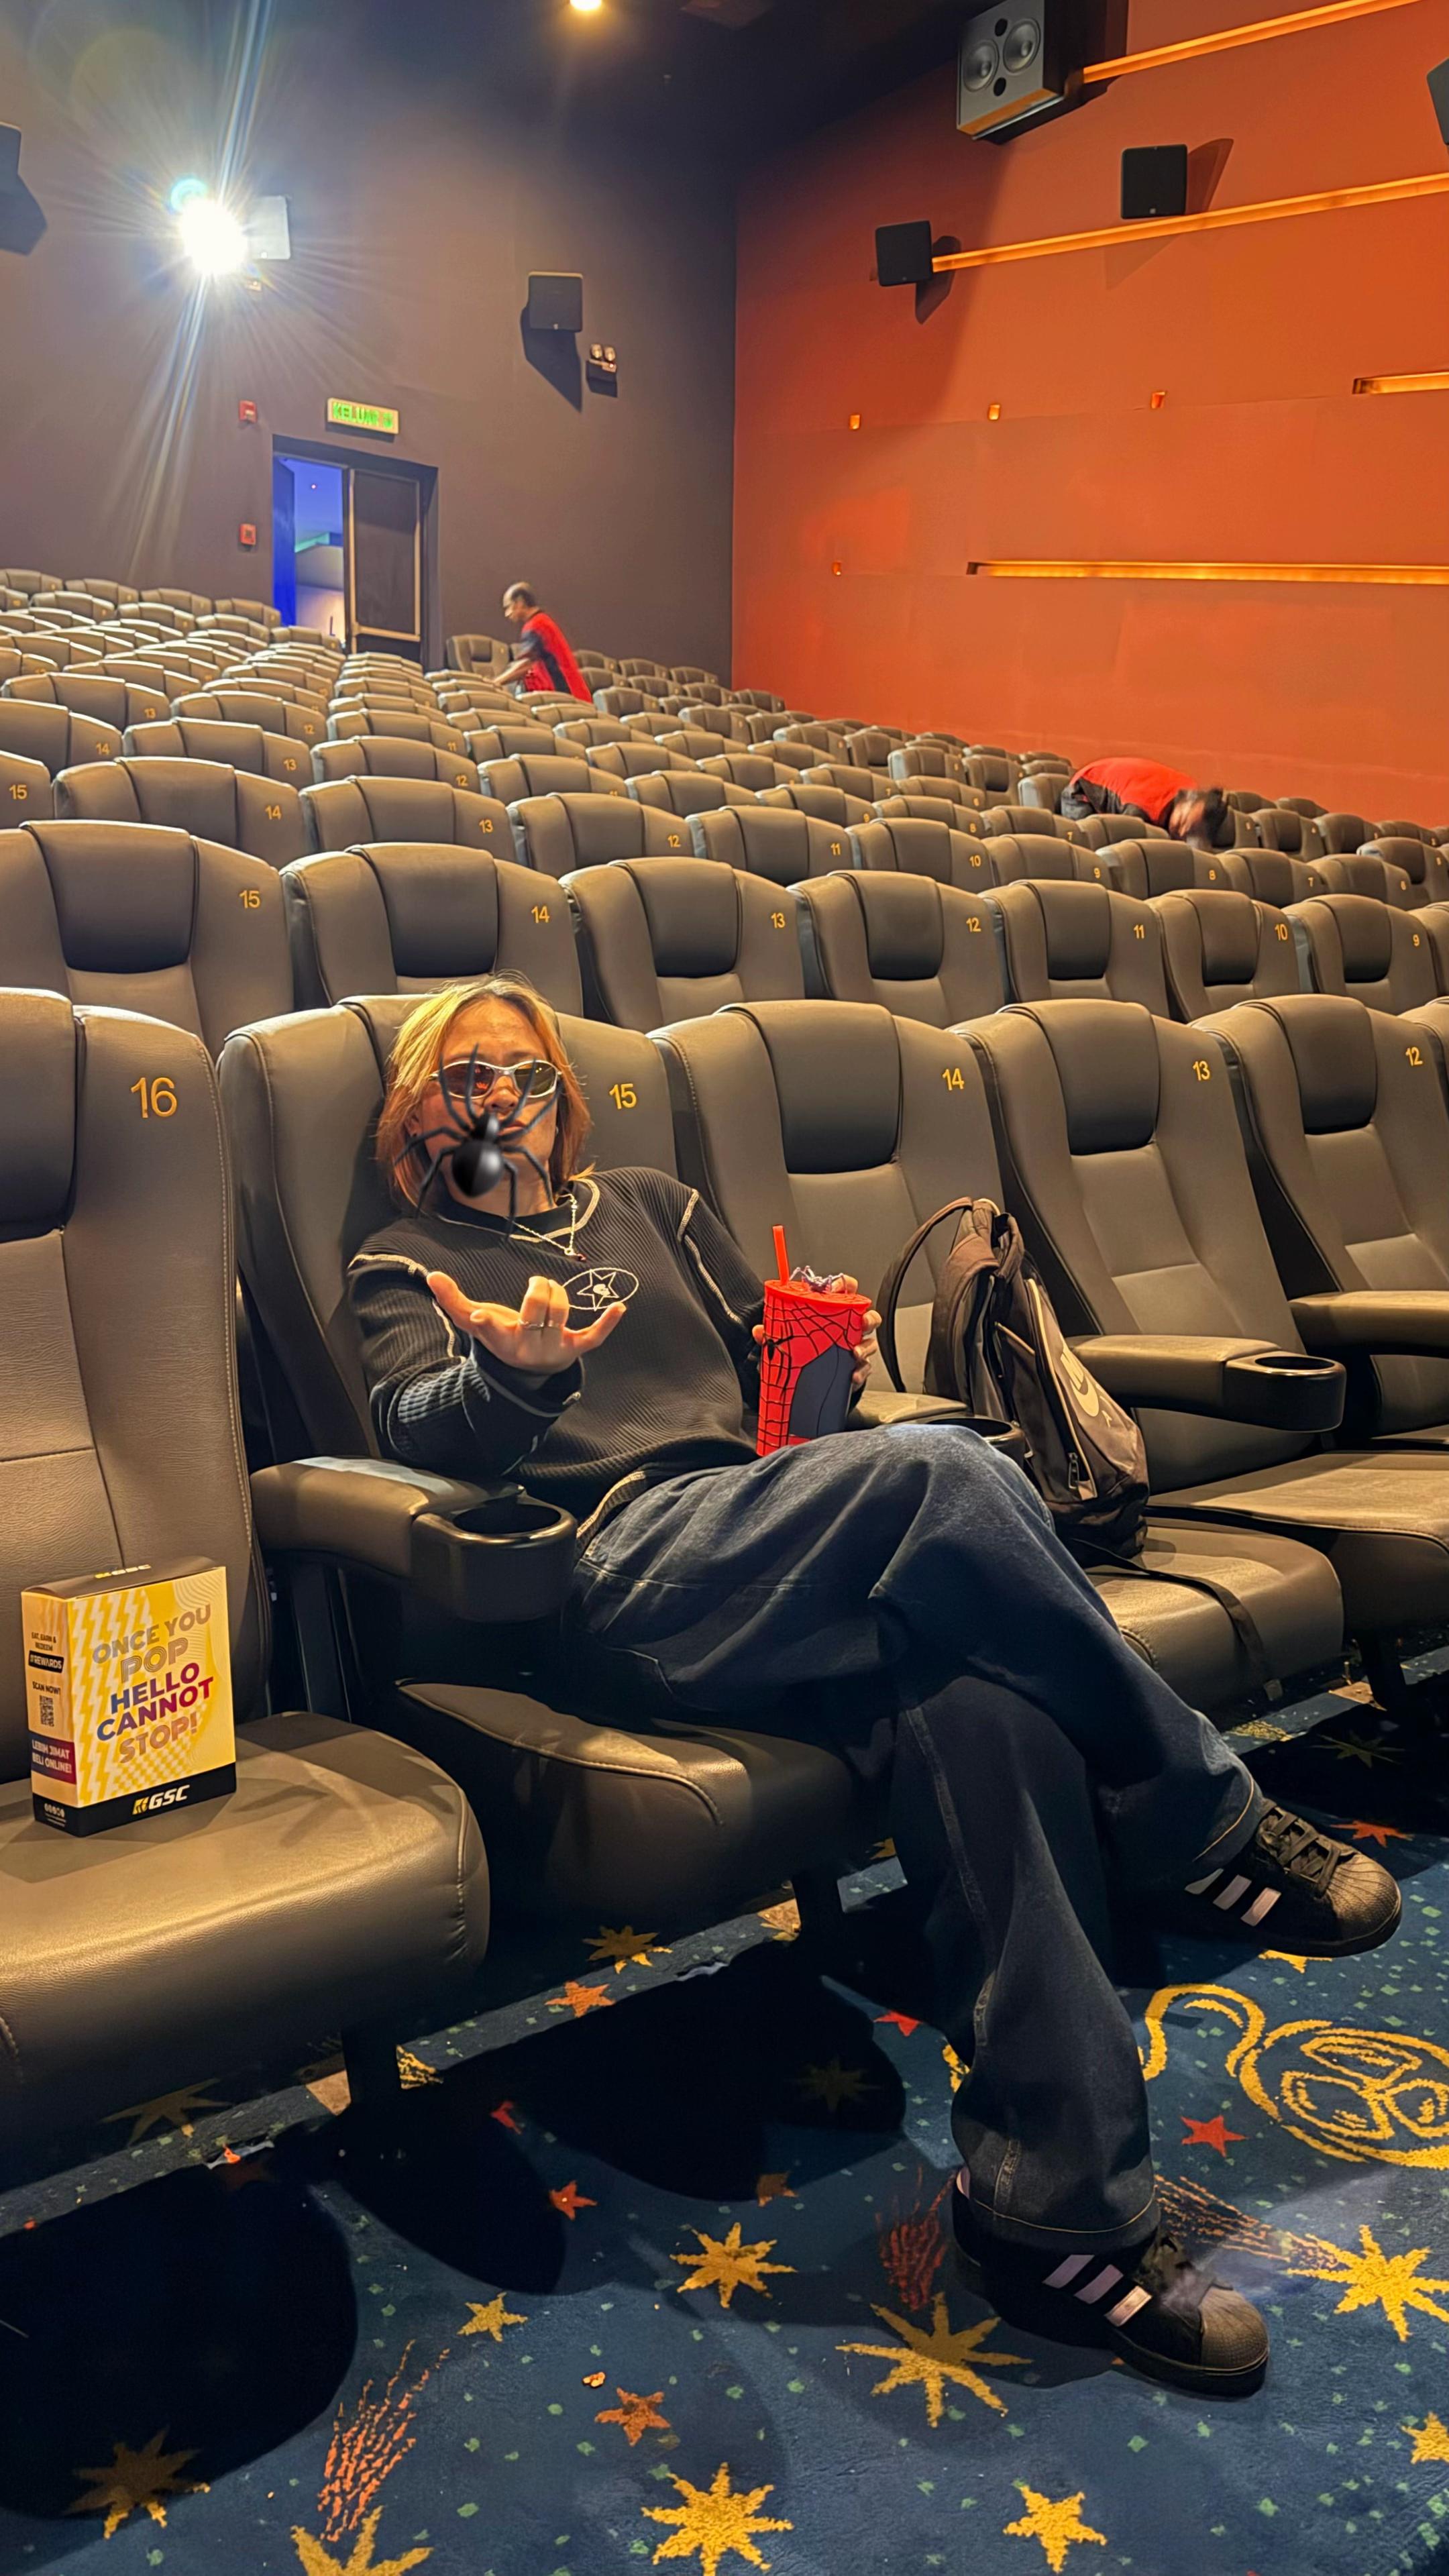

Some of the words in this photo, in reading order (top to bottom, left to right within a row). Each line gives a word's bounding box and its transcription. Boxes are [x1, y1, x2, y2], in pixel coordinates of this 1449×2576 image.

[96, 743, 110, 755] 14
[447, 742, 458, 753] 11
[284, 759, 297, 771] 13
[456, 775, 468, 787] 12
[9, 784, 28, 800] 15
[265, 805, 282, 819] 14
[863, 813, 870, 823] 9
[479, 819, 493, 833] 13
[667, 835, 680, 847] 12
[1067, 831, 1073, 841] 7
[830, 843, 841, 855] 11
[969, 855, 981, 867] 10
[1093, 867, 1101, 879] 9
[1209, 869, 1216, 881] 8
[1307, 877, 1314, 887] 7
[239, 890, 260, 908] 15
[531, 906, 550, 924] 14
[771, 912, 786, 928] 13
[966, 917, 981, 932] 12
[1133, 924, 1144, 938] 11
[1275, 923, 1288, 941] 10
[1413, 934, 1420, 947] 9
[1405, 1046, 1423, 1066] 12
[1193, 1061, 1210, 1081] 13
[942, 1068, 965, 1091] 14
[131, 1077, 177, 1118] 16
[609, 1083, 637, 1110] 15
[93, 1624, 160, 1664] ONCE
[164, 1604, 211, 1637] YOU
[120, 1637, 189, 1684] POP
[32, 1680, 45, 1690] SCAN
[110, 1662, 200, 1715] HELLO
[97, 1676, 214, 1741] CANNOT
[119, 1711, 197, 1764] STOP!
[50, 1745, 70, 1760] JIMAT
[32, 1752, 44, 1766] BELI
[44, 1757, 72, 1774] ONLINE!
[148, 1784, 191, 1810] GSC
